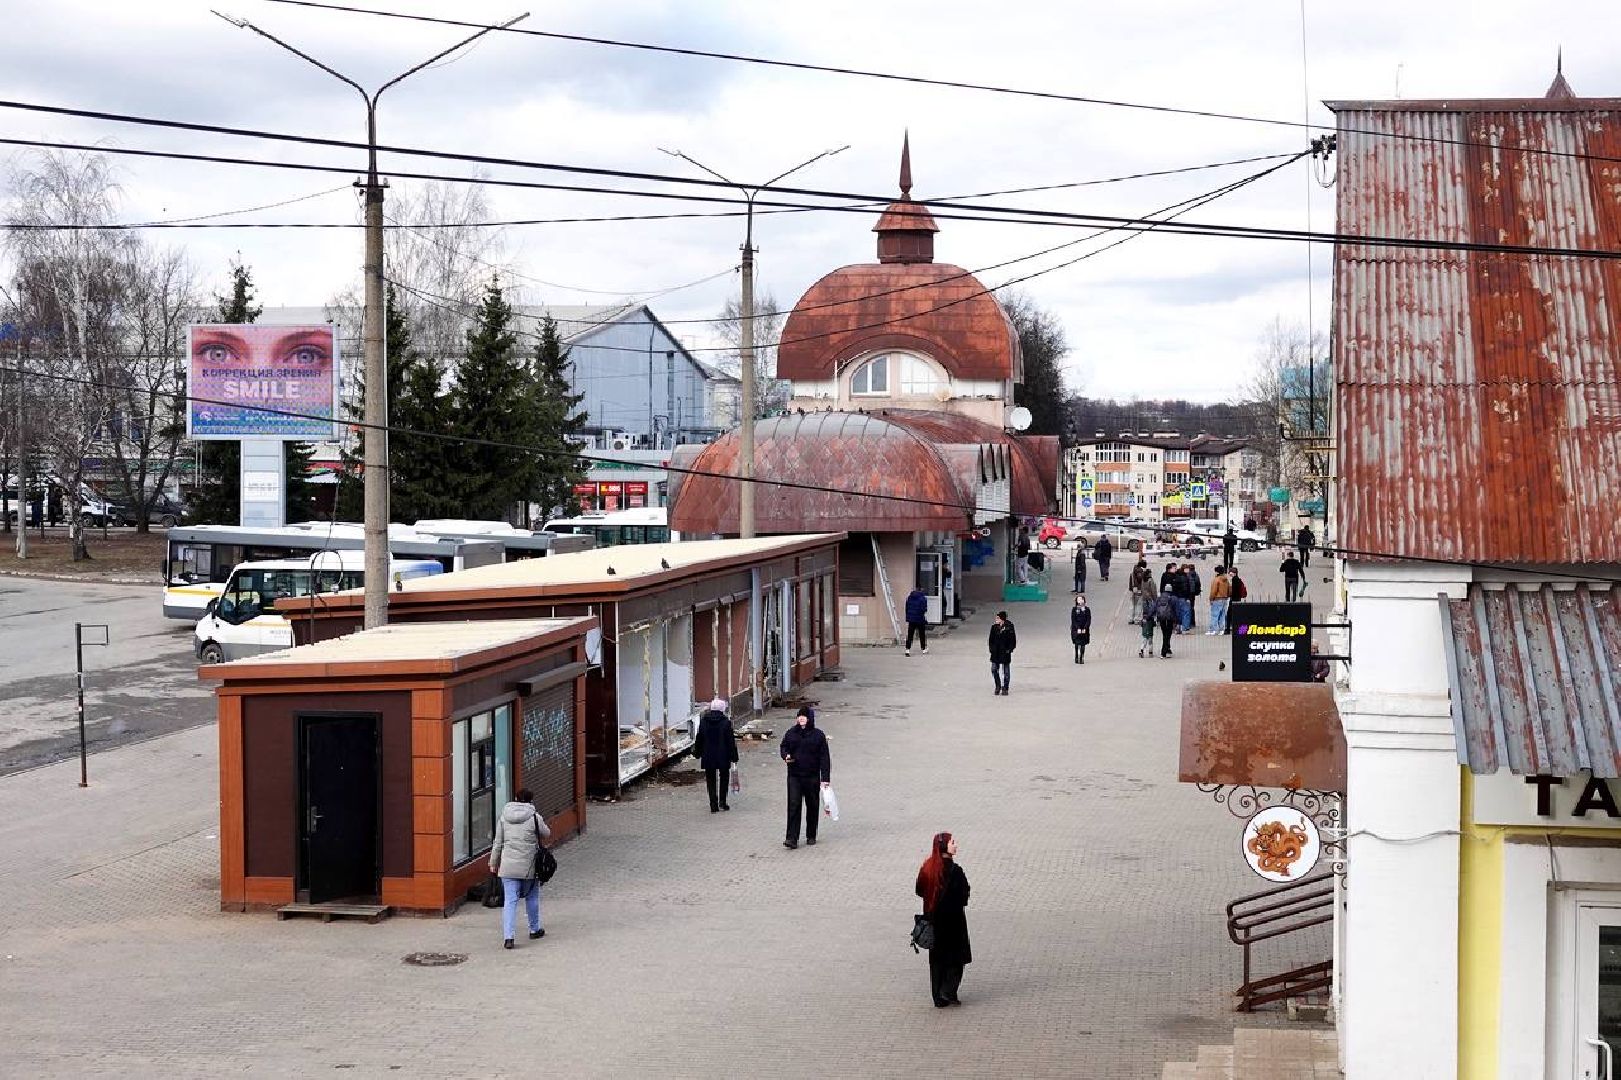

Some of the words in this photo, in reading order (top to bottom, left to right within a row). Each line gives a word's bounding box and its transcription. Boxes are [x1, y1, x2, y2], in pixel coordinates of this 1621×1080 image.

[202, 368, 272, 378] КОРРЕКЦИЯ
[276, 368, 322, 378] ЗРЕНИЯ
[223, 380, 301, 399] SMILE
[1238, 624, 1306, 636] #Ломбард
[1249, 641, 1295, 652] скупка
[1247, 653, 1296, 662] золота
